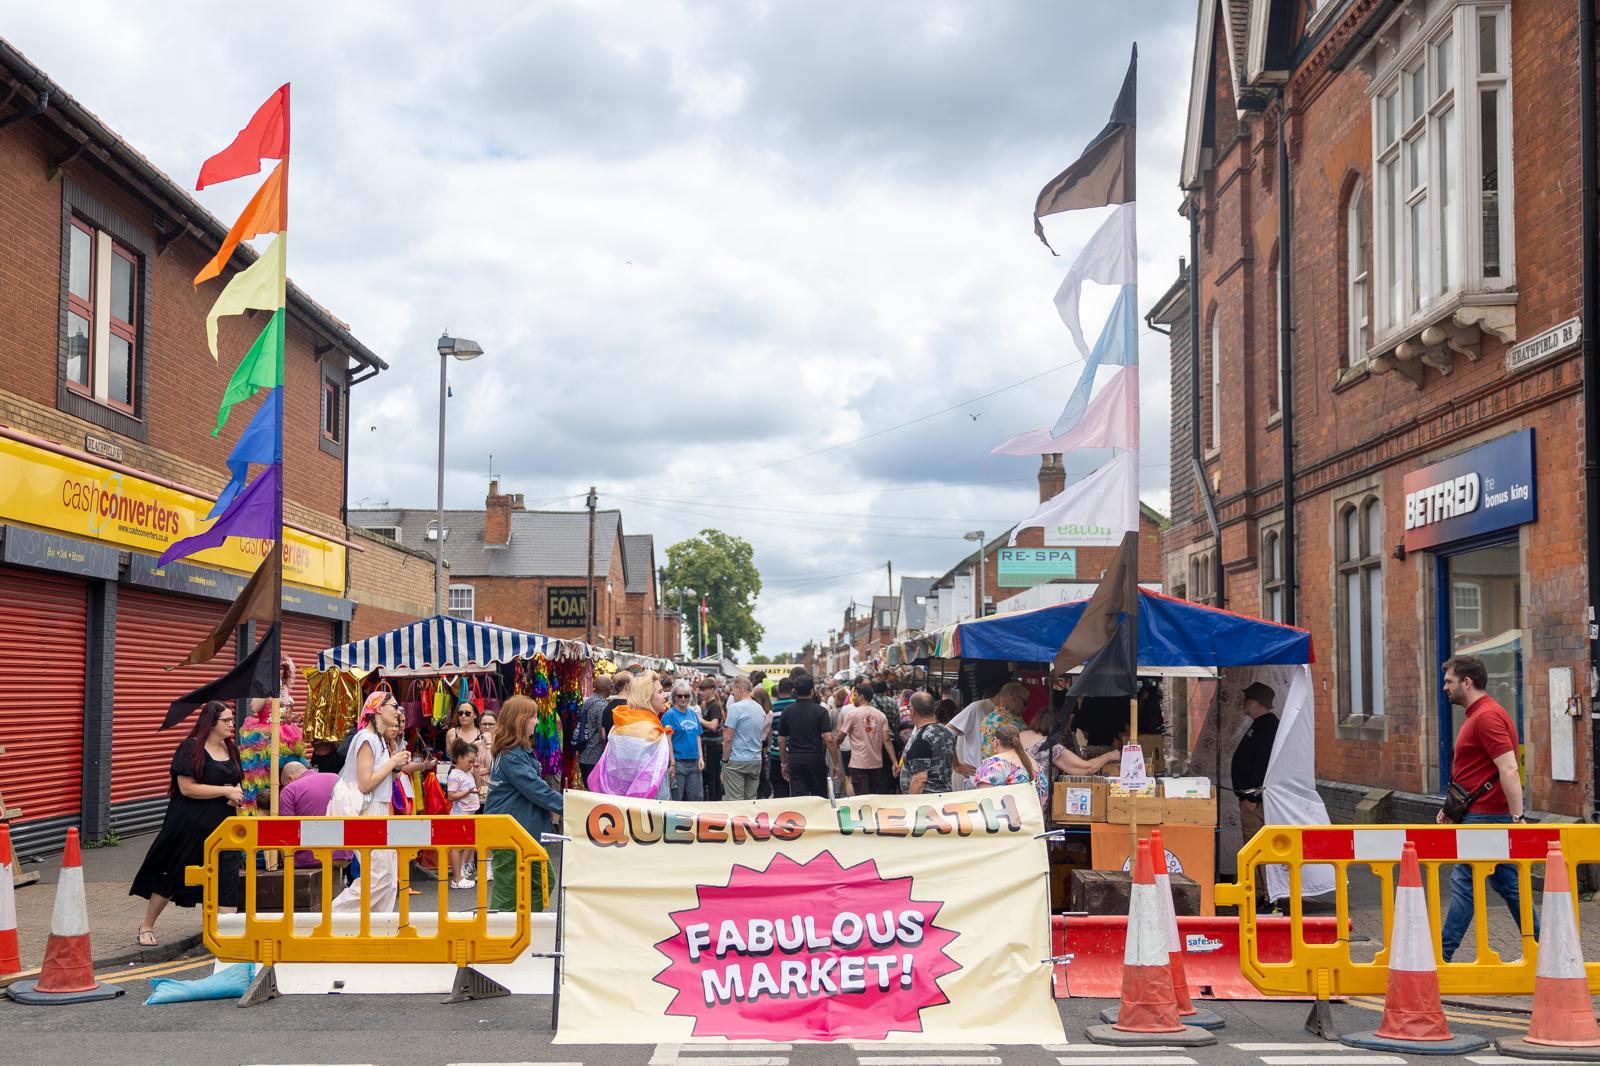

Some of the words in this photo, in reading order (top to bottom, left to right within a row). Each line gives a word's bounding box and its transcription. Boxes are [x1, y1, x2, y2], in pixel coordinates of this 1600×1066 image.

[1511, 333, 1558, 365] HEATHFIELD
[1405, 472, 1480, 530] BETFRED
[1485, 478, 1495, 490] the
[1485, 492, 1508, 509] bonus
[1511, 484, 1528, 500] king
[585, 803, 807, 846] QUEENS
[836, 794, 1022, 839] HEATH
[685, 909, 924, 963] FABULOUS
[701, 952, 915, 1008] MARKET!
